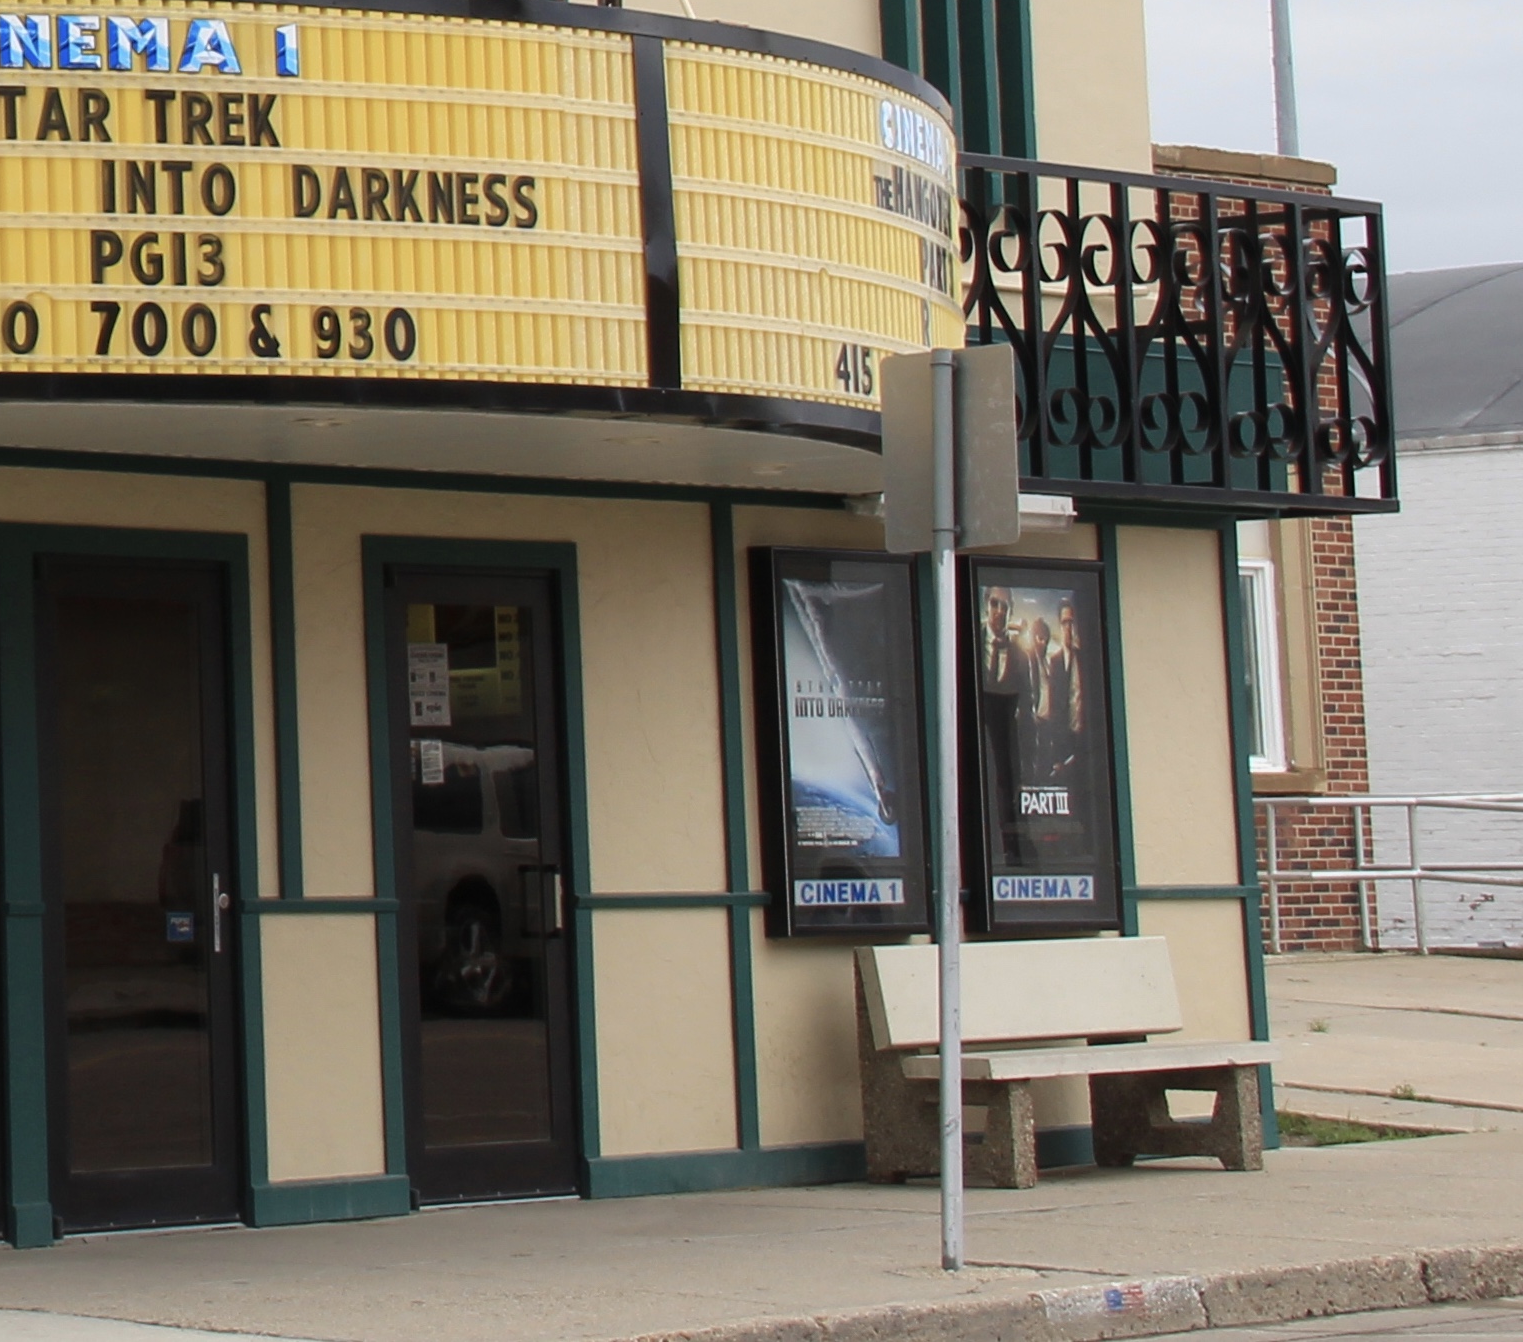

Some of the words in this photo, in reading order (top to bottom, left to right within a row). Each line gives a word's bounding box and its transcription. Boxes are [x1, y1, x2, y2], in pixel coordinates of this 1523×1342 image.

[274, 23, 300, 76] 1
[145, 89, 281, 149] TREK
[101, 160, 236, 216] INTO
[292, 164, 538, 229] DARKNESS
[873, 175, 893, 211] THE
[90, 301, 218, 357] 700
[249, 304, 281, 358] &
[312, 305, 416, 361] 930
[836, 344, 872, 396] 415
[795, 697, 824, 717] INTO
[1021, 792, 1053, 814] PART
[1055, 792, 1070, 814] III
[800, 882, 881, 903] CINEMA
[889, 883, 898, 902] 1
[997, 878, 1071, 898] CINEMA
[1079, 878, 1089, 898] 2
